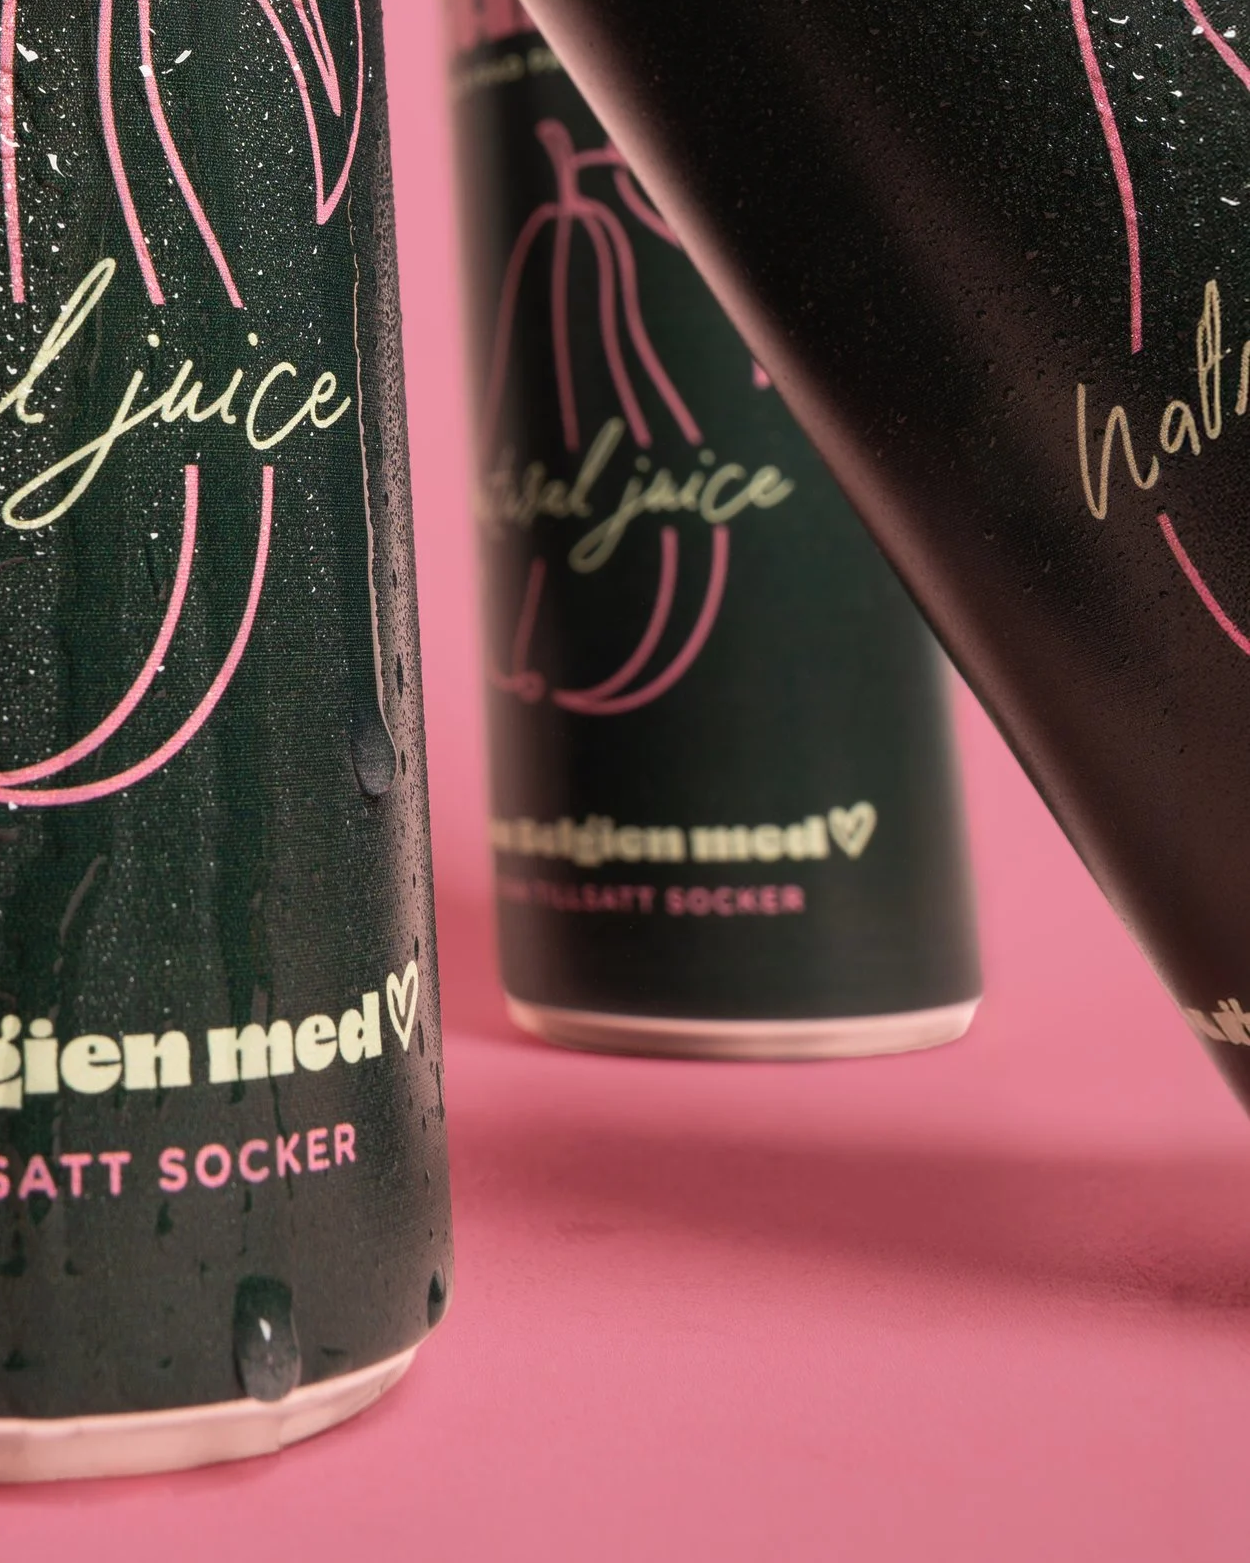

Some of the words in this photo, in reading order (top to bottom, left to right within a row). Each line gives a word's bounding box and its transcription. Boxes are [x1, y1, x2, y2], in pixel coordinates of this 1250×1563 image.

[2, 331, 353, 531] juice
[566, 447, 796, 574] juice
[689, 813, 830, 864] med
[663, 883, 806, 917] SOCKER
[207, 990, 383, 1086] med
[157, 1121, 359, 1194] SOCKER
